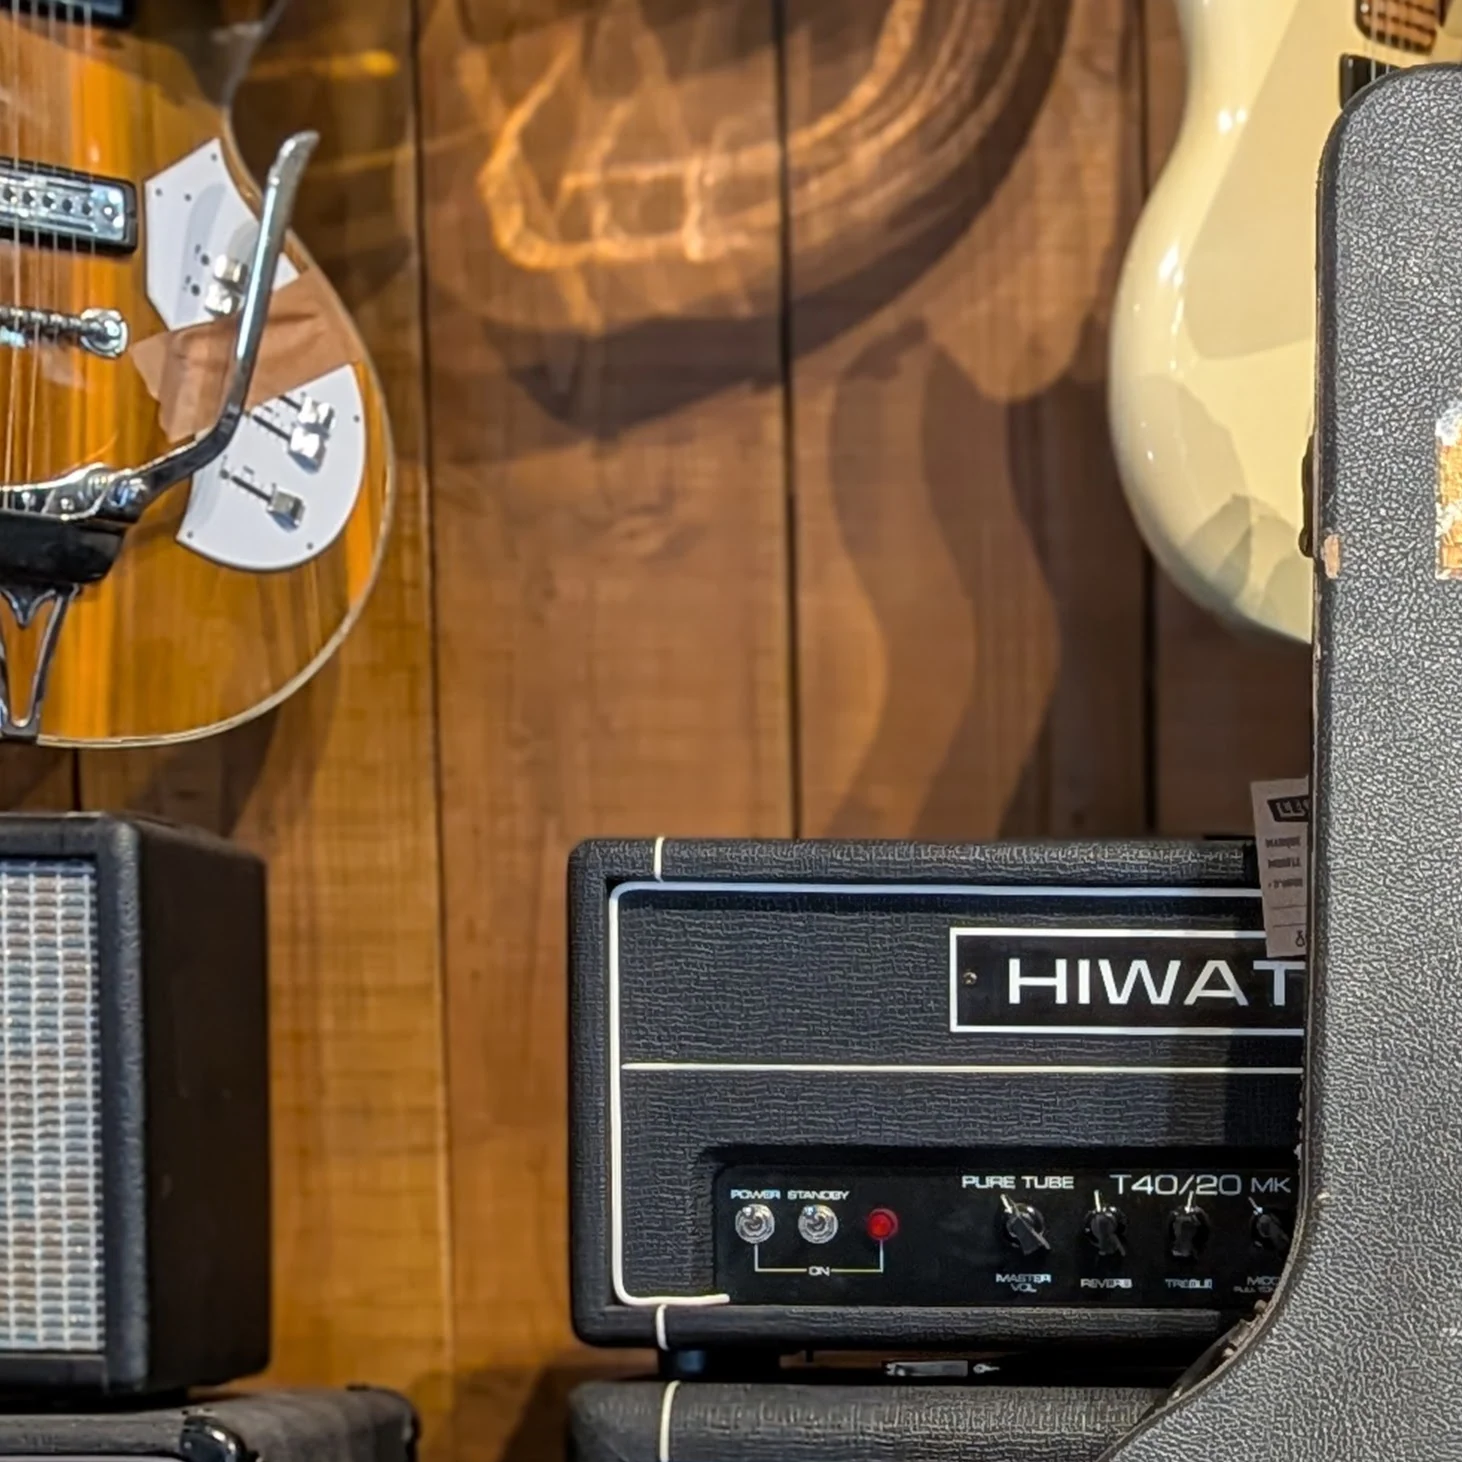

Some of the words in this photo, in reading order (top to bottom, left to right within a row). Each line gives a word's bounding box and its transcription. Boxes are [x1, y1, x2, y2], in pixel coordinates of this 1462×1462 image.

[961, 1175, 1016, 1189] PURE
[1021, 1176, 1075, 1189] TUBE
[1109, 1174, 1242, 1196] T40/20
[1250, 1177, 1291, 1193] MK
[731, 1189, 781, 1200] POWER
[787, 1190, 849, 1200] STANDBY
[808, 1266, 830, 1276] ON
[996, 1273, 1052, 1283] MASTER
[1080, 1278, 1133, 1289] REVERB
[1165, 1278, 1213, 1289] TREBLE
[1010, 1283, 1037, 1293] VOL
